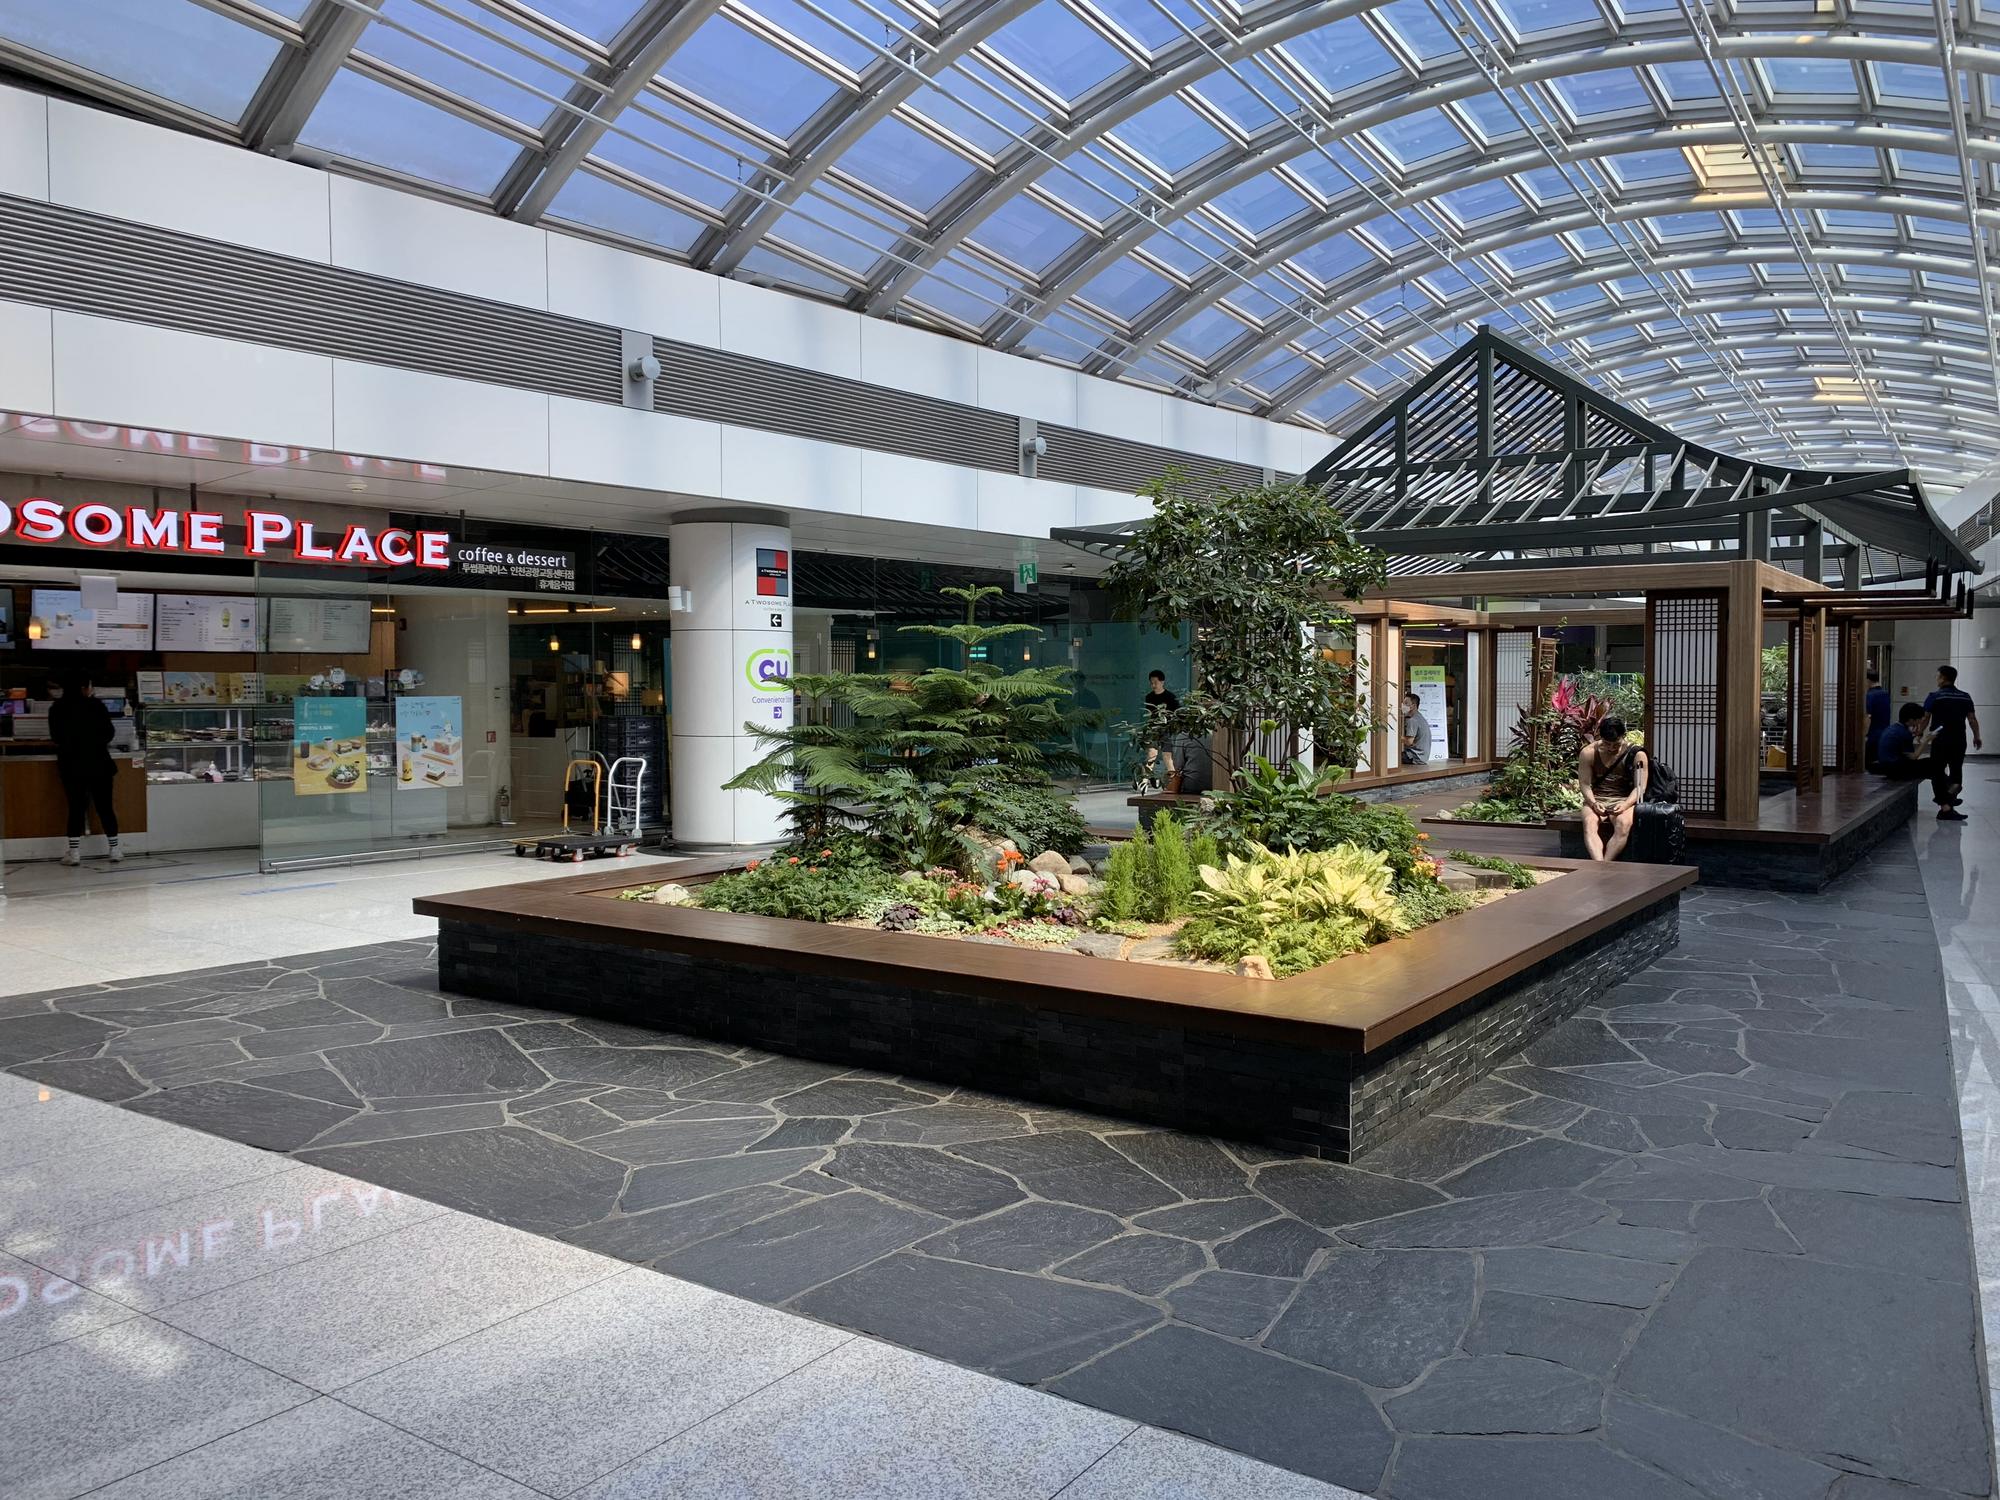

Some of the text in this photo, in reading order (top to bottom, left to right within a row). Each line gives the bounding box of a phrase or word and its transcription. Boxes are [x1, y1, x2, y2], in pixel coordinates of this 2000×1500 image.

[0, 499, 450, 568] SOME PLACE
[458, 547, 567, 568] coffee & dessert
[462, 563, 508, 575] 투썸플레이스
[539, 580, 575, 591] 휴게음식점
[759, 660, 788, 680] CU
